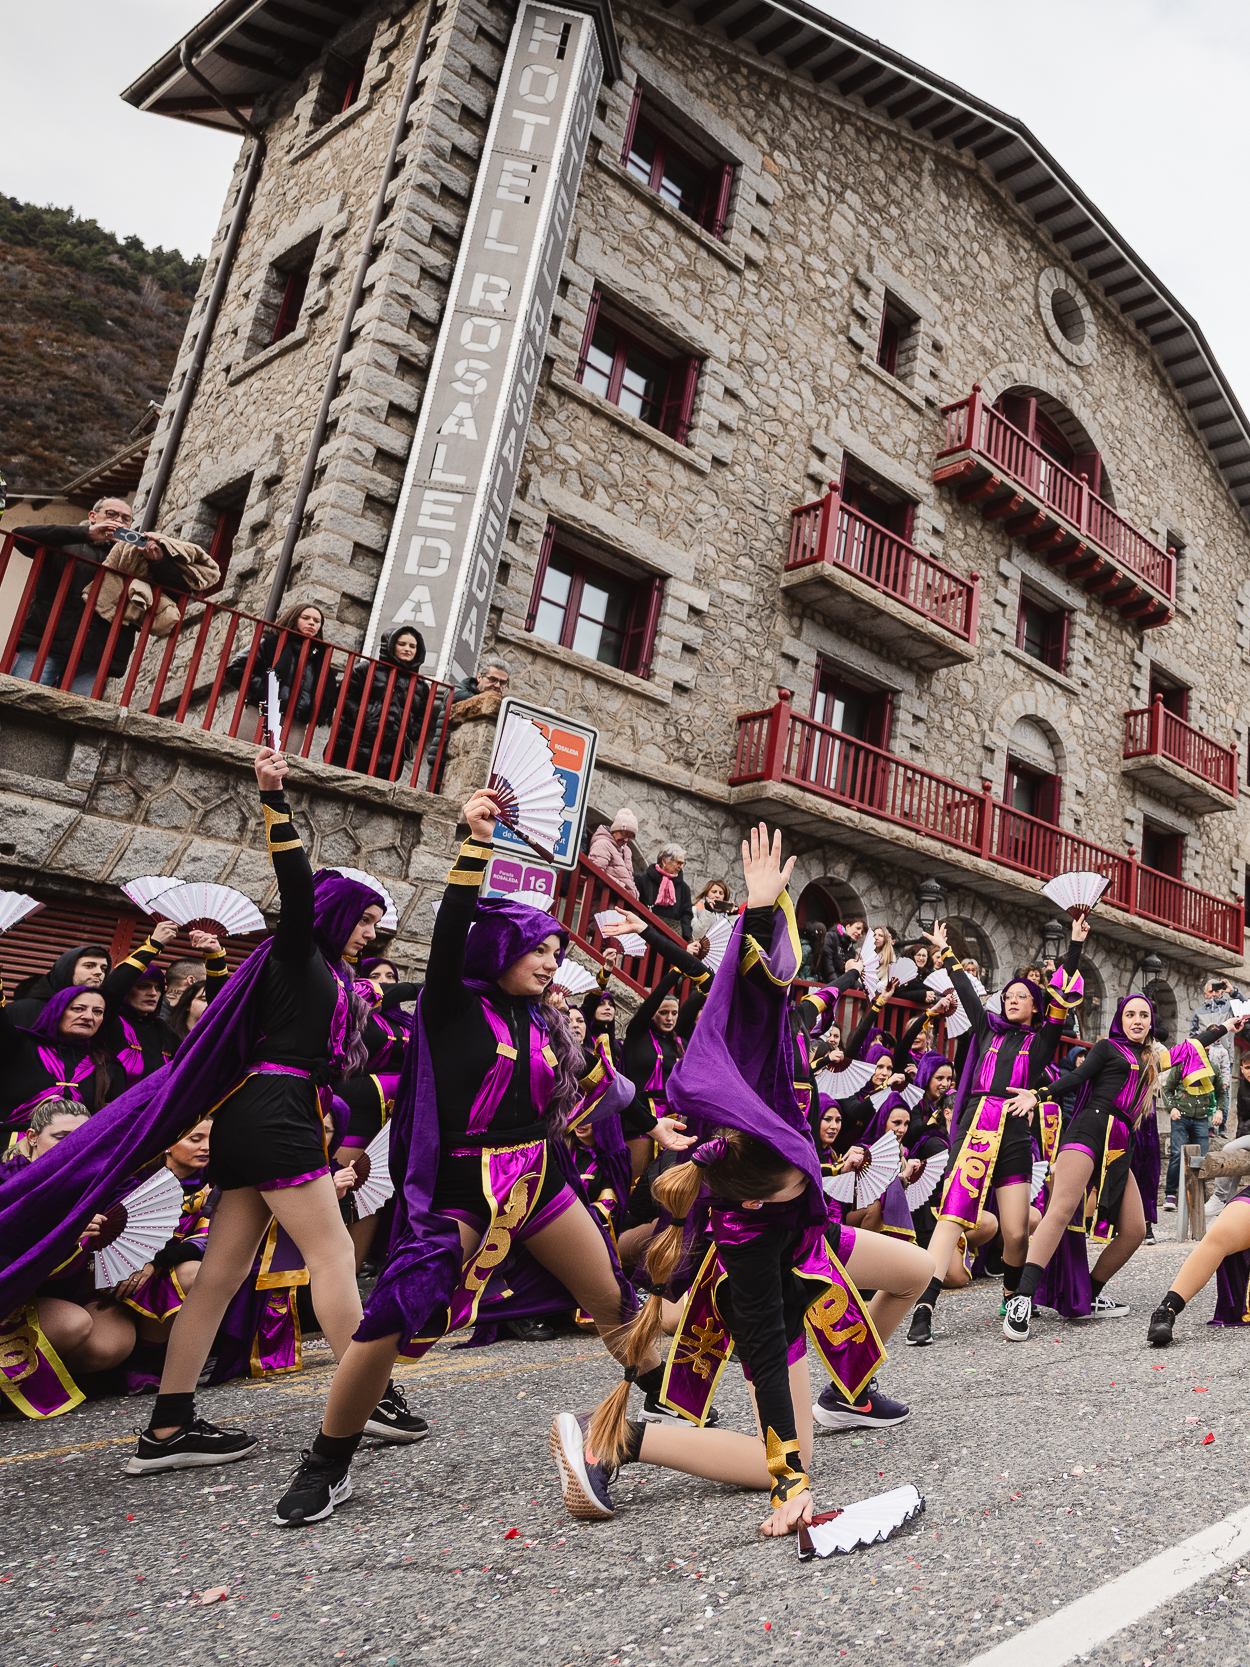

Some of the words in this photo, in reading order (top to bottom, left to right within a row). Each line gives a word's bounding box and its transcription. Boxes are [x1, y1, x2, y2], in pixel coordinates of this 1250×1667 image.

[483, 15, 572, 255] HOTEL
[543, 43, 600, 290] HOTEL
[391, 271, 512, 628] ROSALEDA
[461, 295, 545, 653] ROSALEDA
[554, 743, 579, 757] ROSALEDA
[493, 873, 518, 884] ROSALEDA
[502, 830, 512, 839] de
[529, 875, 546, 892] 16
